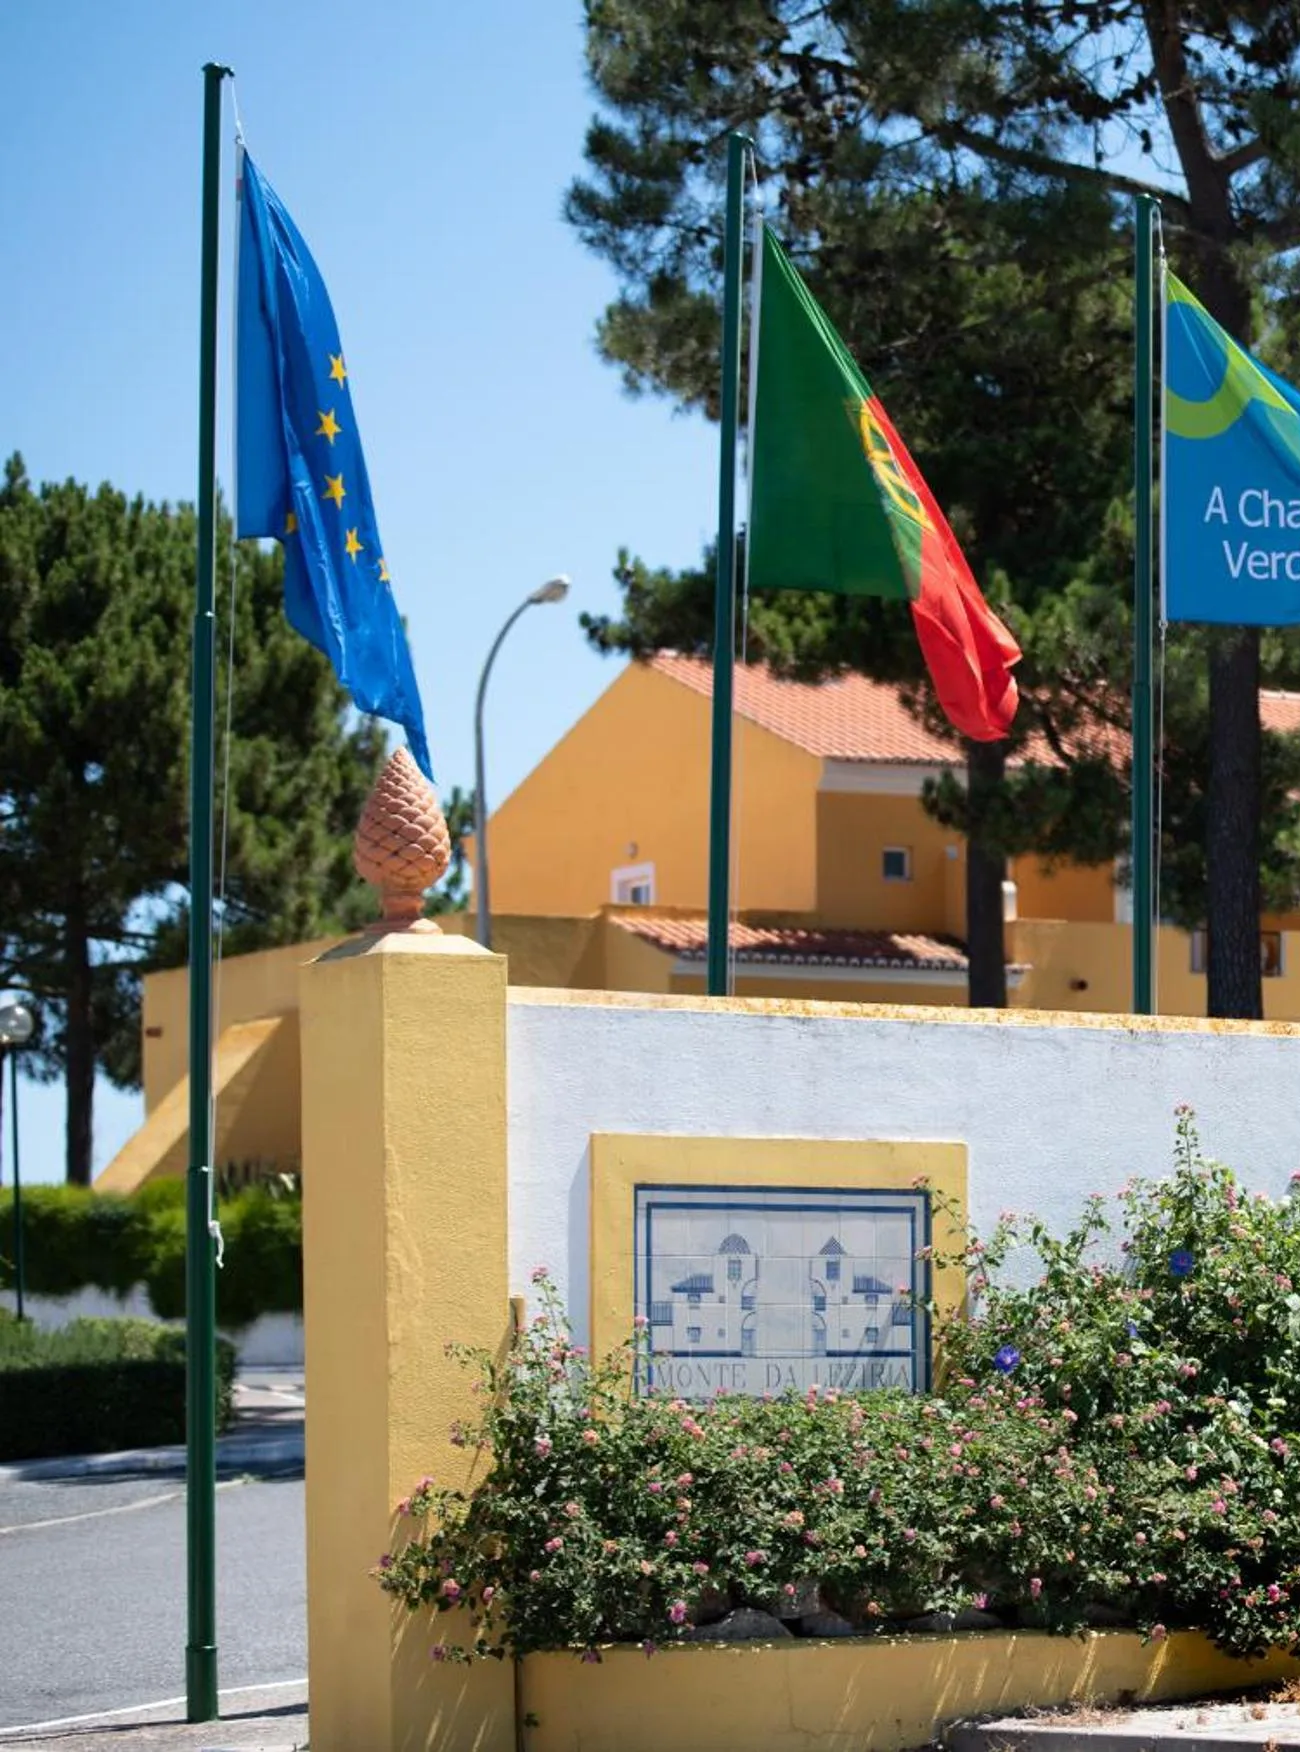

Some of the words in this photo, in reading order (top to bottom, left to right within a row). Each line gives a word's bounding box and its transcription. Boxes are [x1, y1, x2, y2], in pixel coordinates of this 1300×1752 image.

[1204, 486, 1228, 524] A
[657, 1363, 747, 1387] MONTE
[766, 1363, 797, 1388] DA
